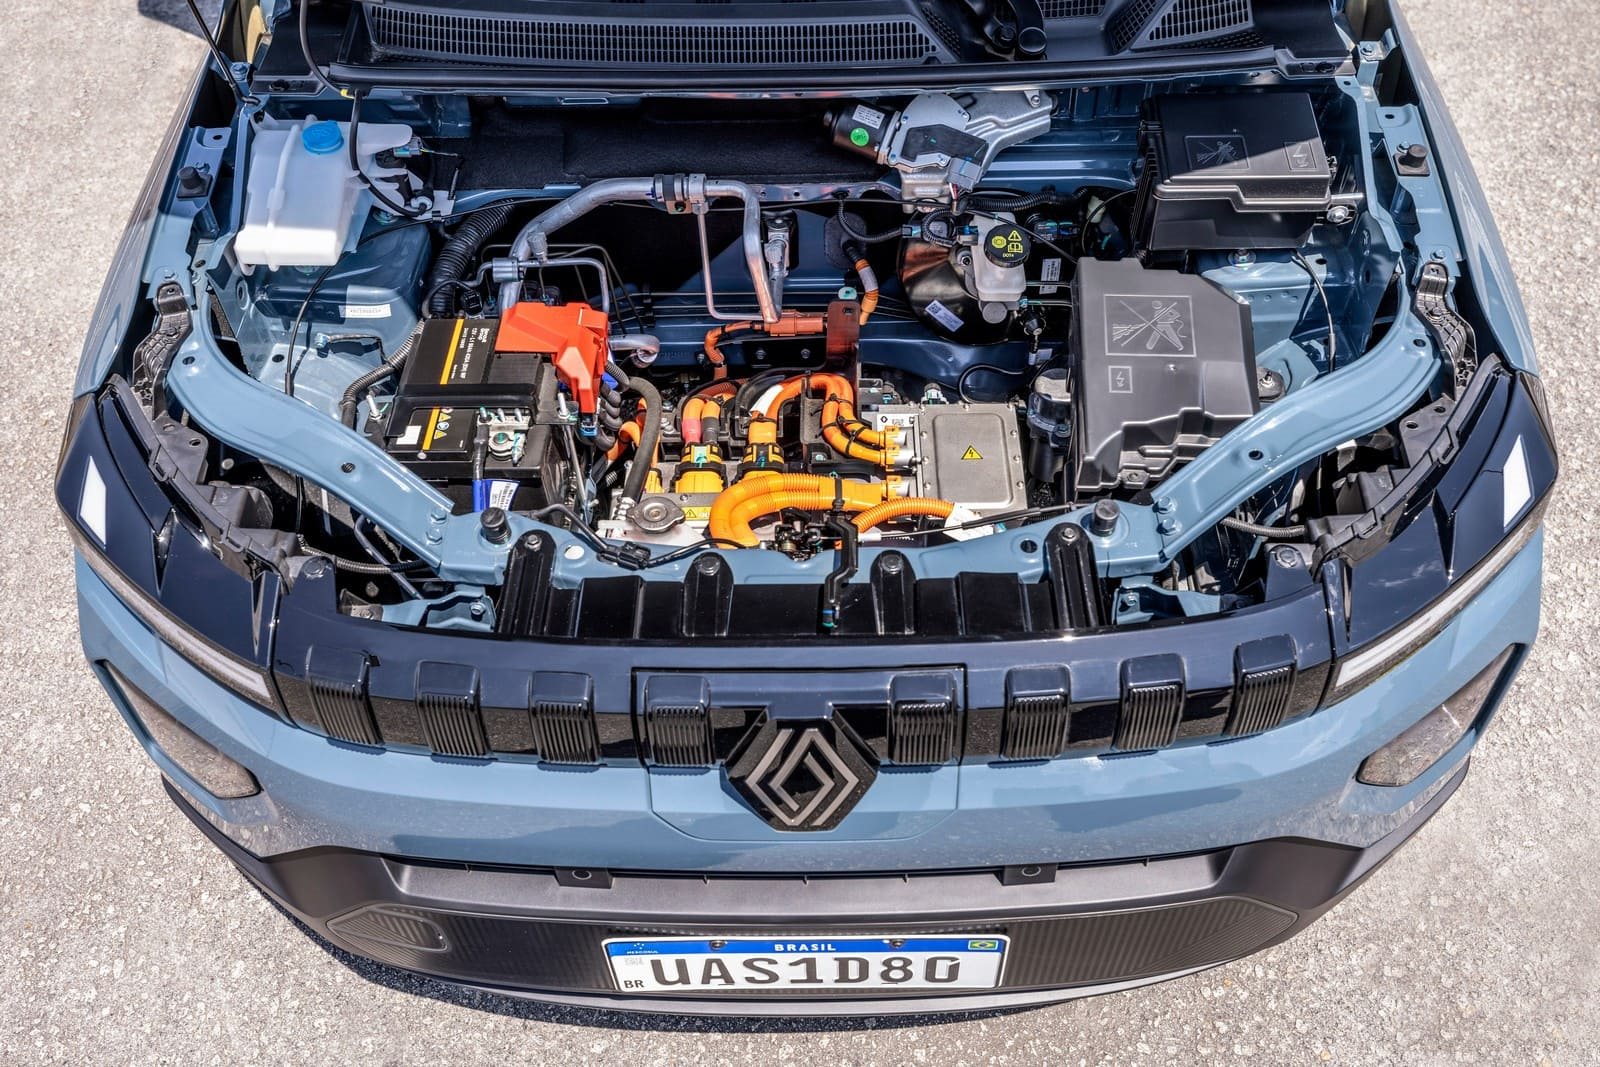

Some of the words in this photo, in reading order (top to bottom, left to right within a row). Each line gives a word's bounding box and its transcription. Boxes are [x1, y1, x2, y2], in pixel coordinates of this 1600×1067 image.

[774, 943, 837, 951] BRASIL
[650, 956, 961, 986] UAS1D80
[623, 979, 645, 989] BR
